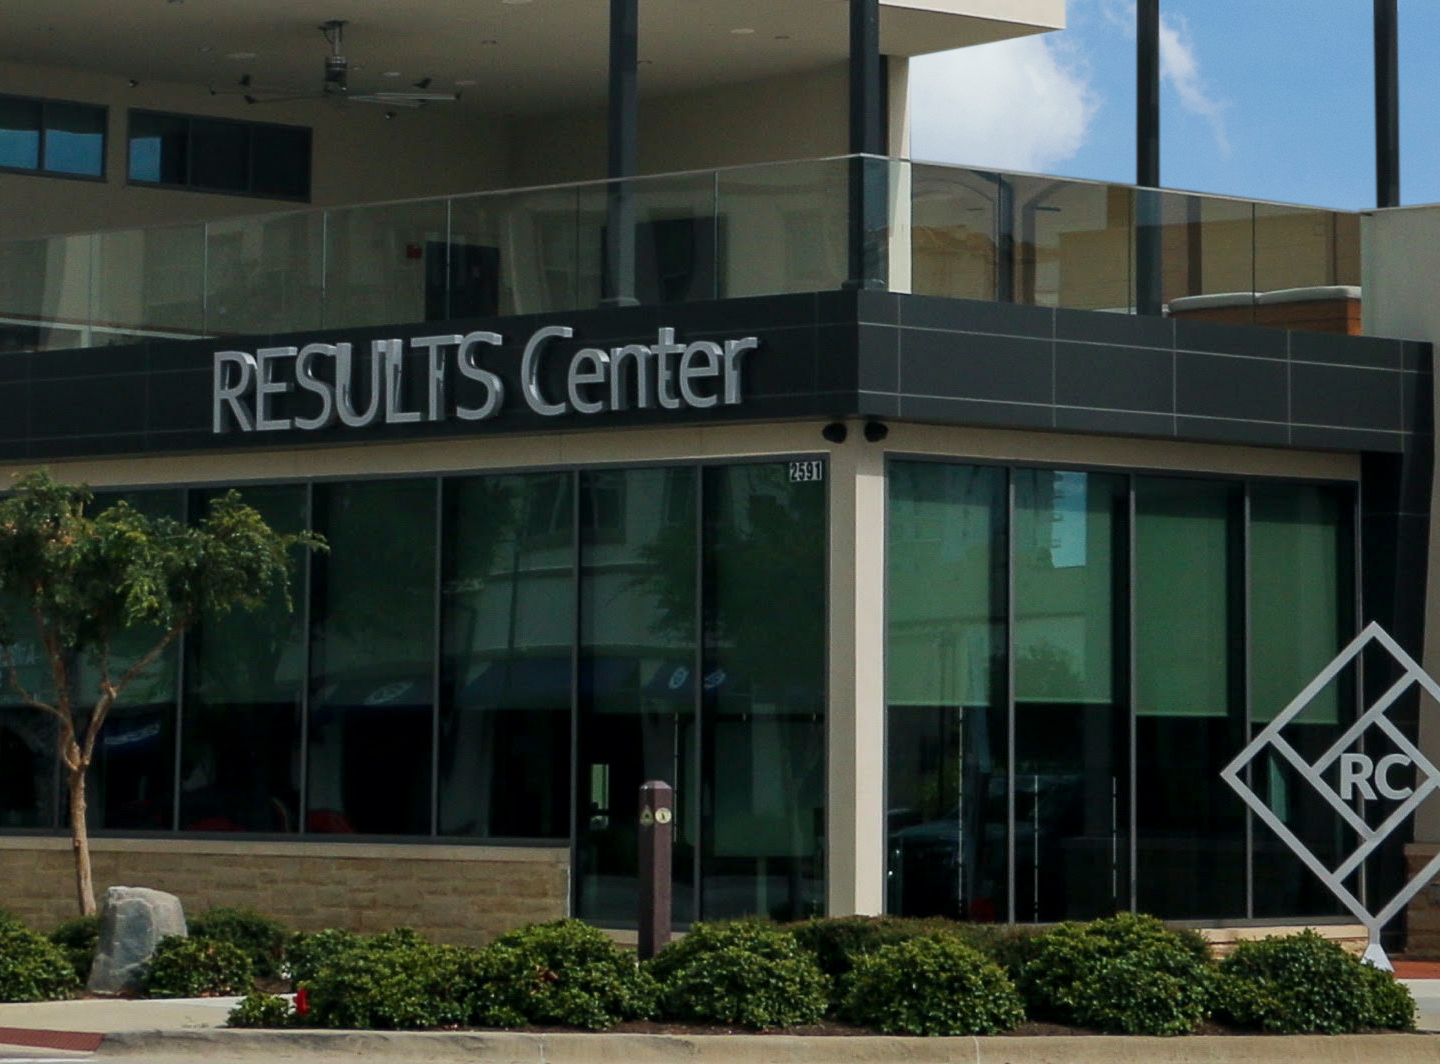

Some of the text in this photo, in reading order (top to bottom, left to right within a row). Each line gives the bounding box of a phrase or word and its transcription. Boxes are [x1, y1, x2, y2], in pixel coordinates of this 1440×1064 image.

[212, 326, 759, 434] RESULTS Center
[790, 462, 821, 481] 2591
[1340, 753, 1413, 800] RC
